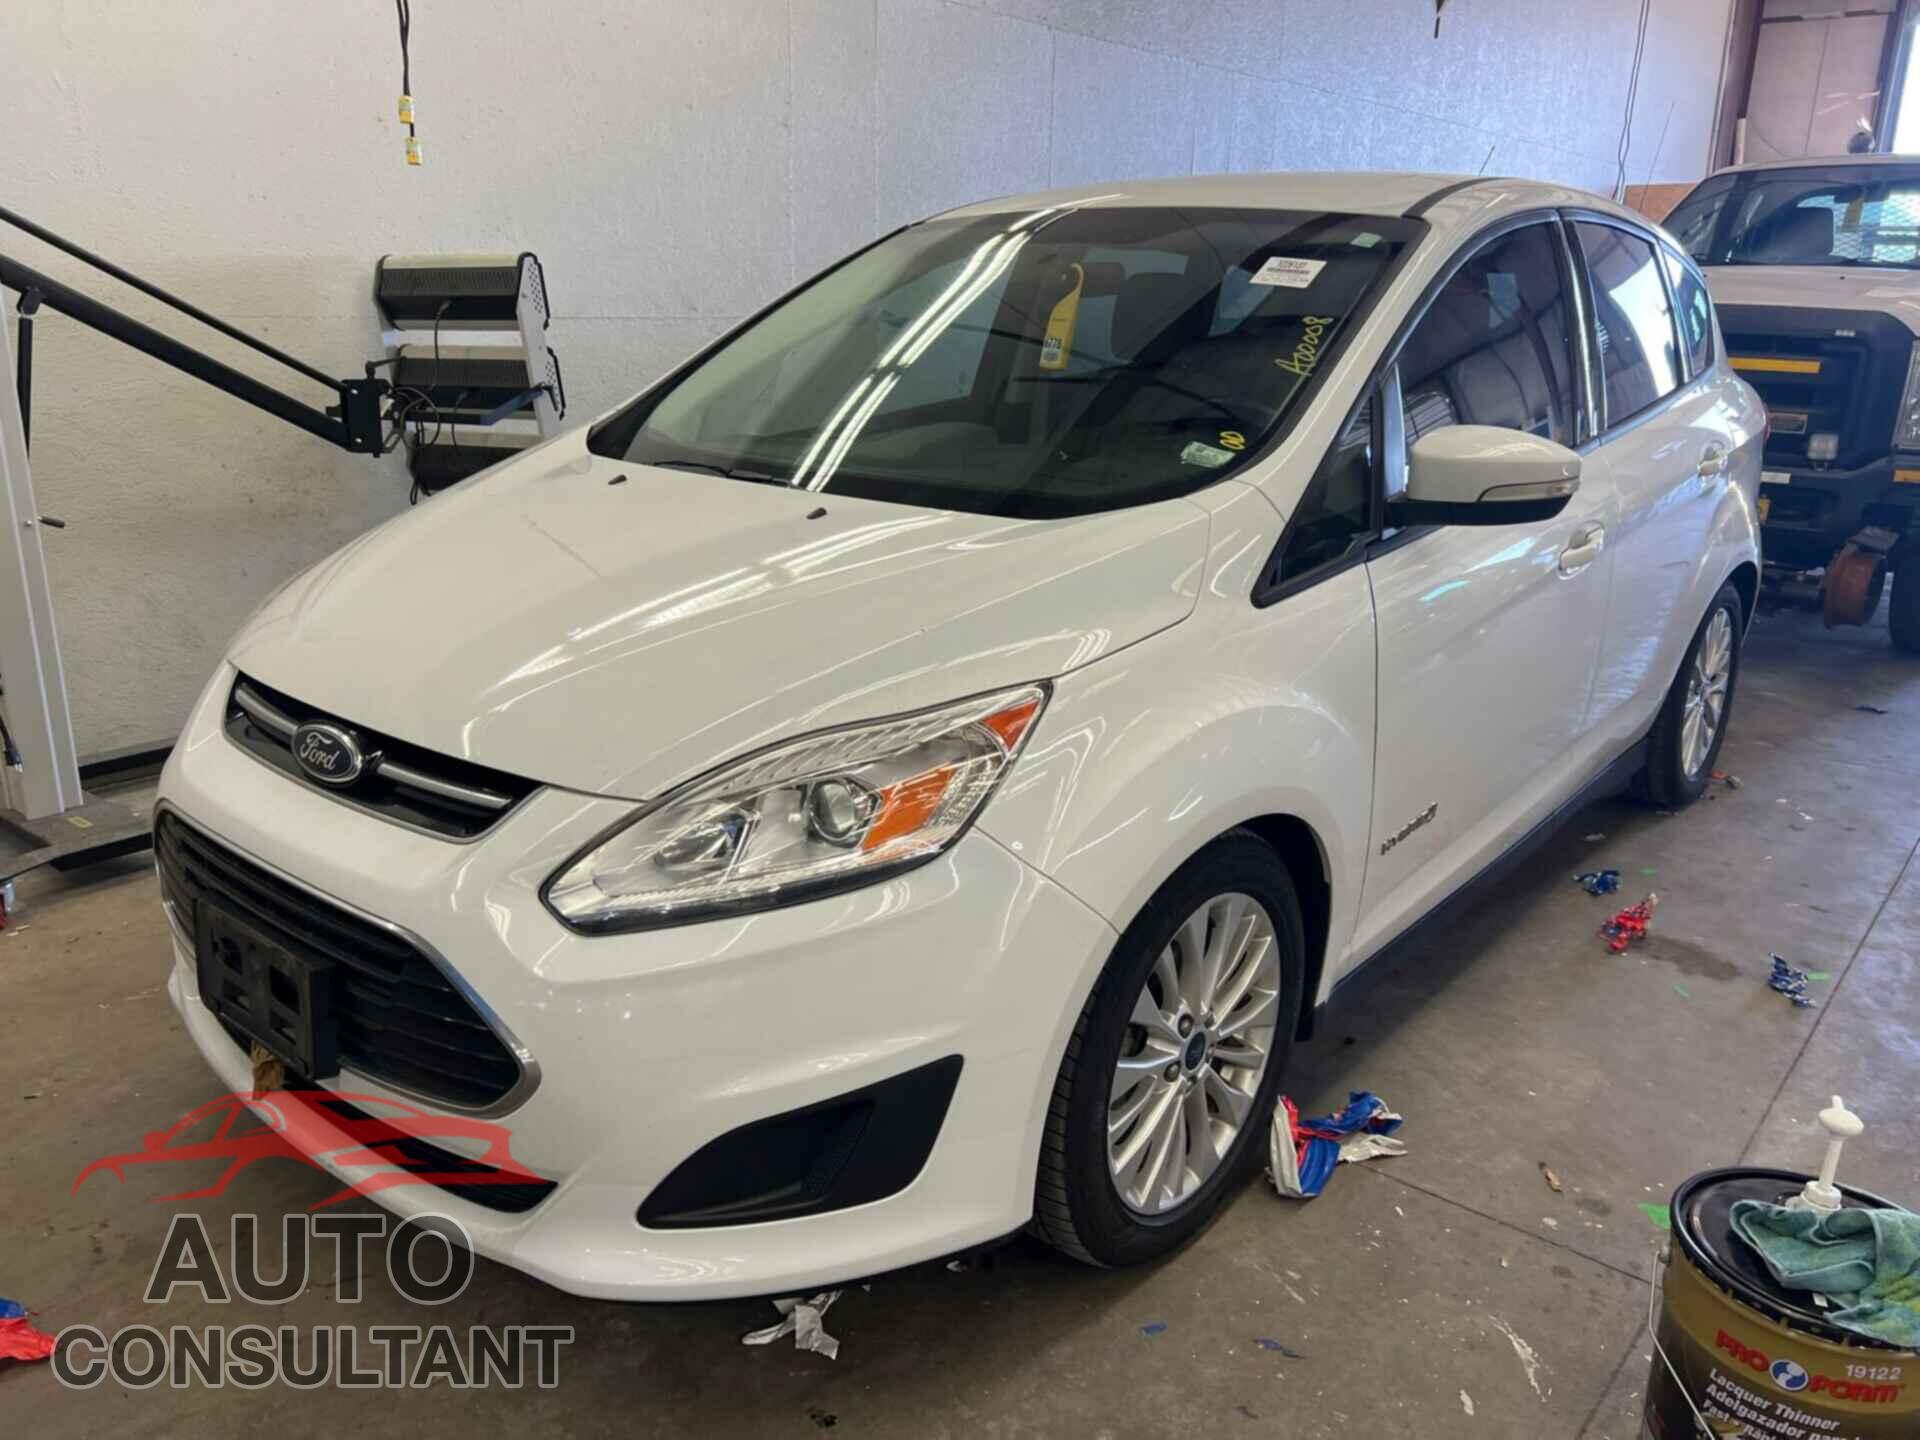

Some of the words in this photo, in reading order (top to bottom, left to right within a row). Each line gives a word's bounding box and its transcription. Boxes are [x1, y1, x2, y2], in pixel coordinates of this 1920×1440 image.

[300, 731, 341, 771] Ford
[1714, 1329, 1771, 1372] PRO
[1845, 1364, 1901, 1381] 19122
[1705, 1383, 1806, 1439] Adelgazador
[1709, 1368, 1772, 1410] Lacquer
[1775, 1403, 1841, 1431] Thinner
